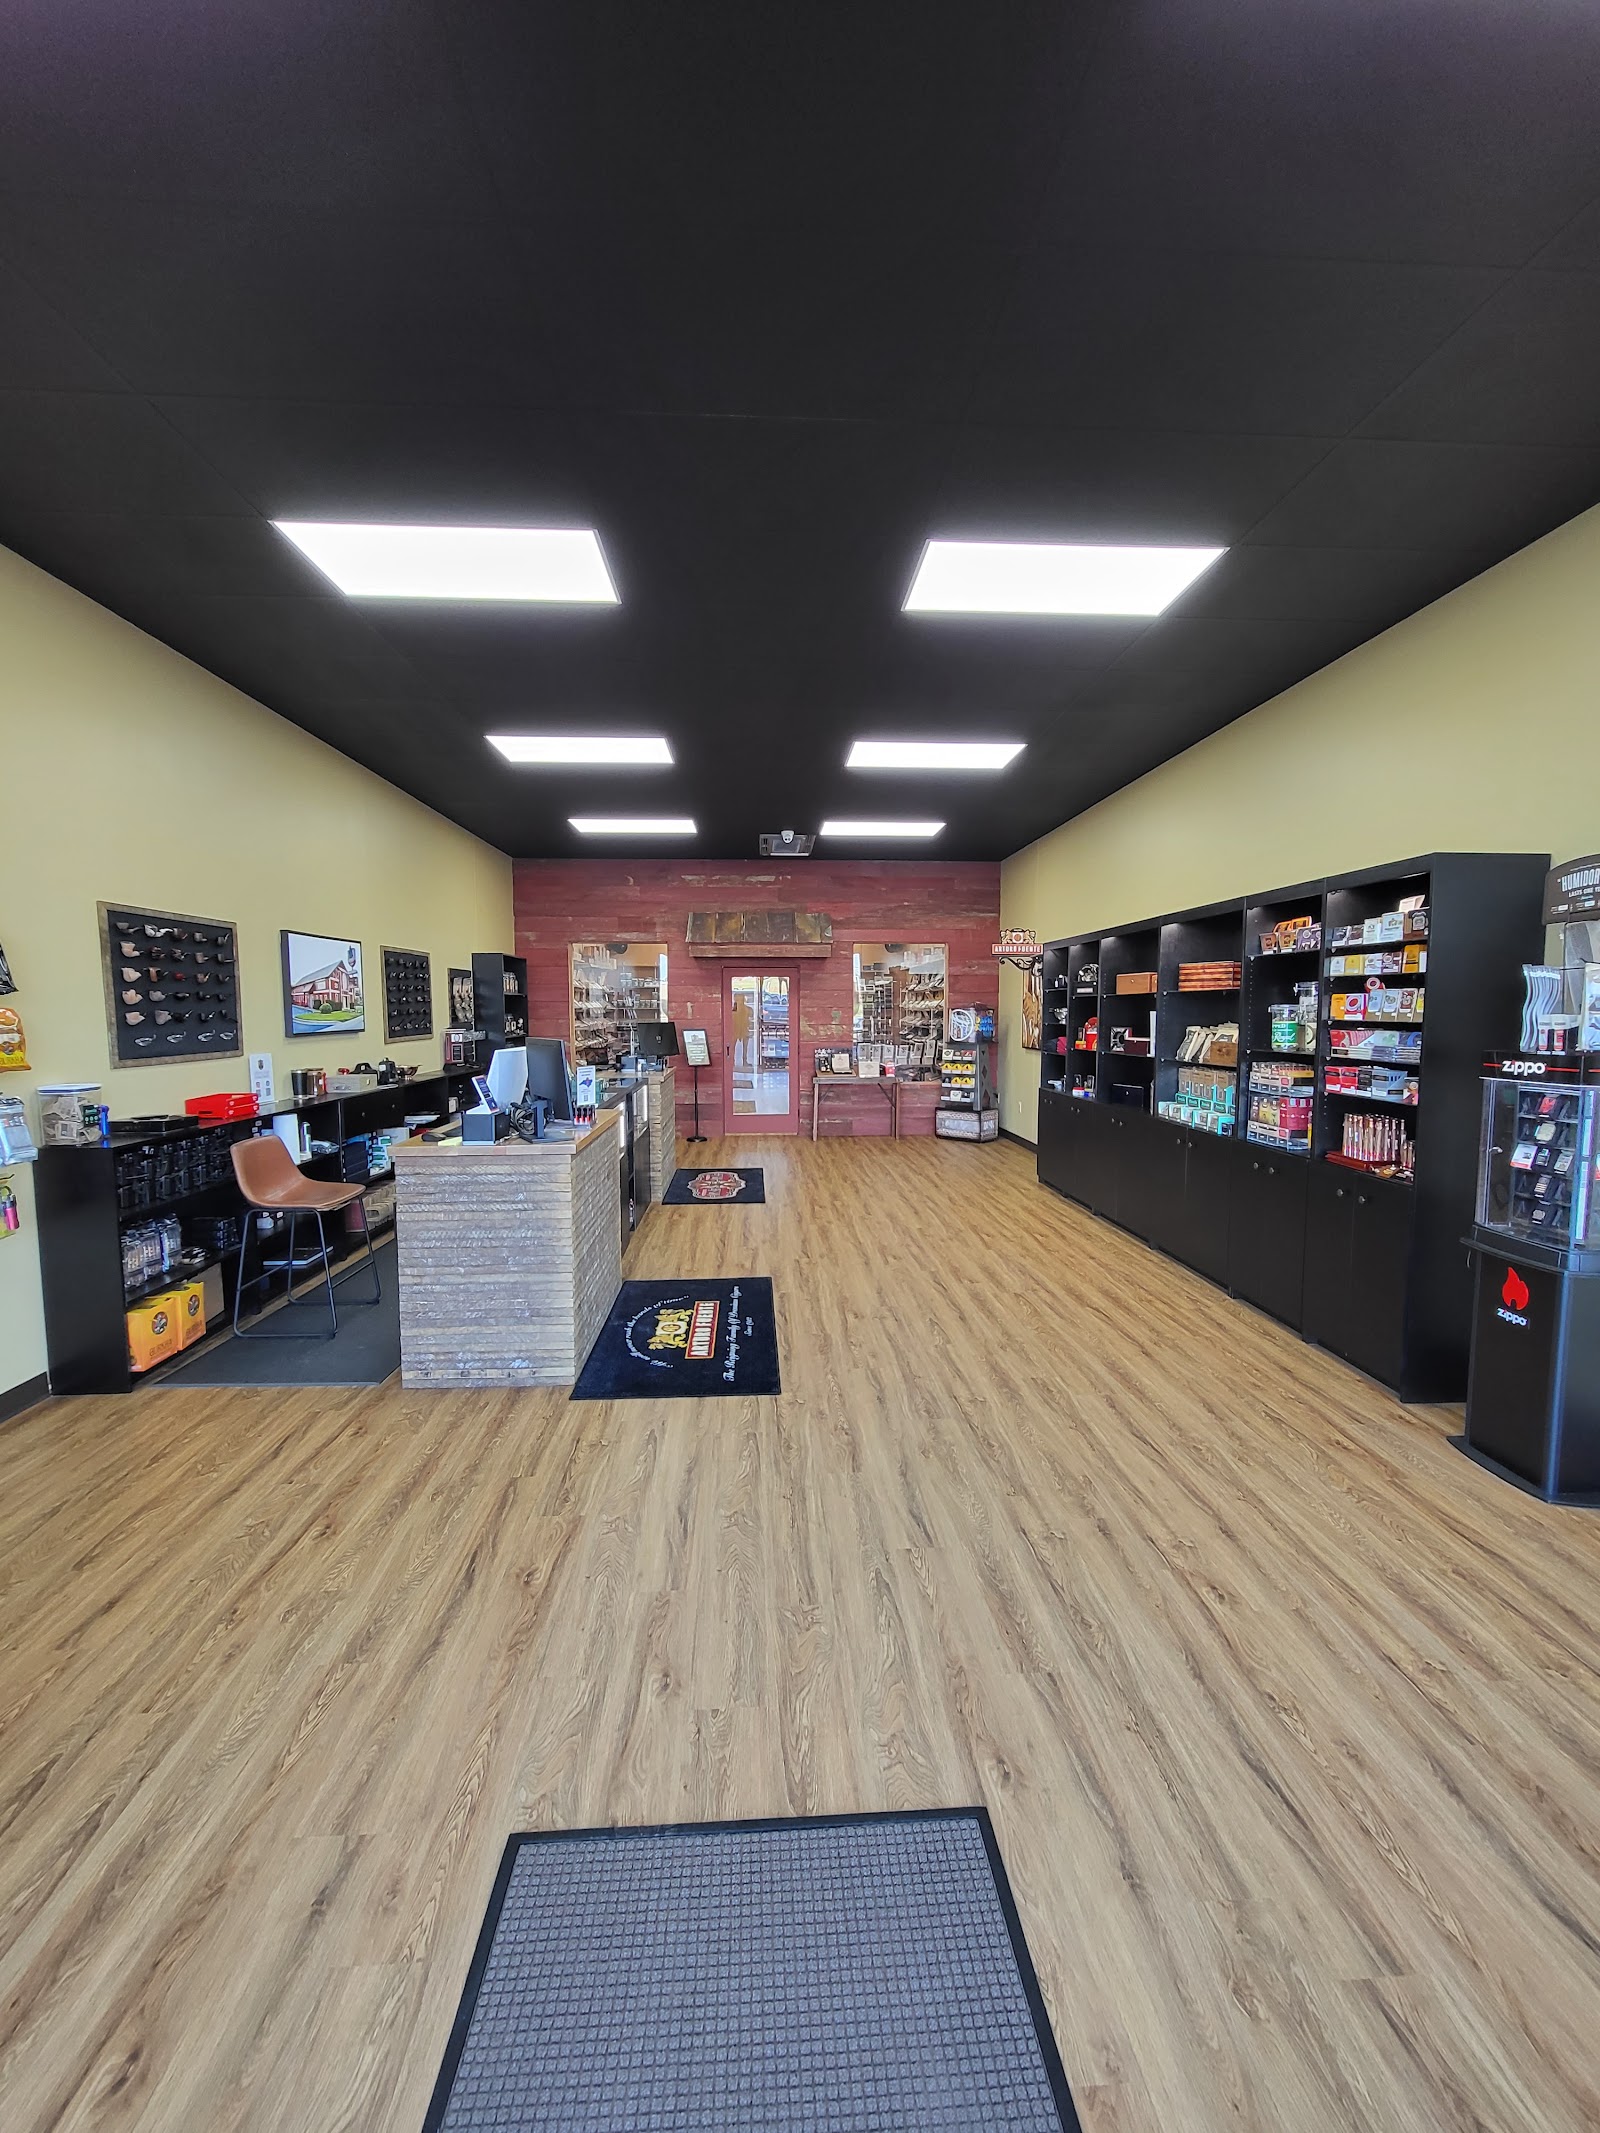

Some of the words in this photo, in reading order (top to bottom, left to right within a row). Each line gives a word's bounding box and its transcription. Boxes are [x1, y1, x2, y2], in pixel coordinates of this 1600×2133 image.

[695, 1302, 715, 1327] FUENTE
[690, 1327, 712, 1356] ARTURO
[723, 1369, 735, 1382] The
